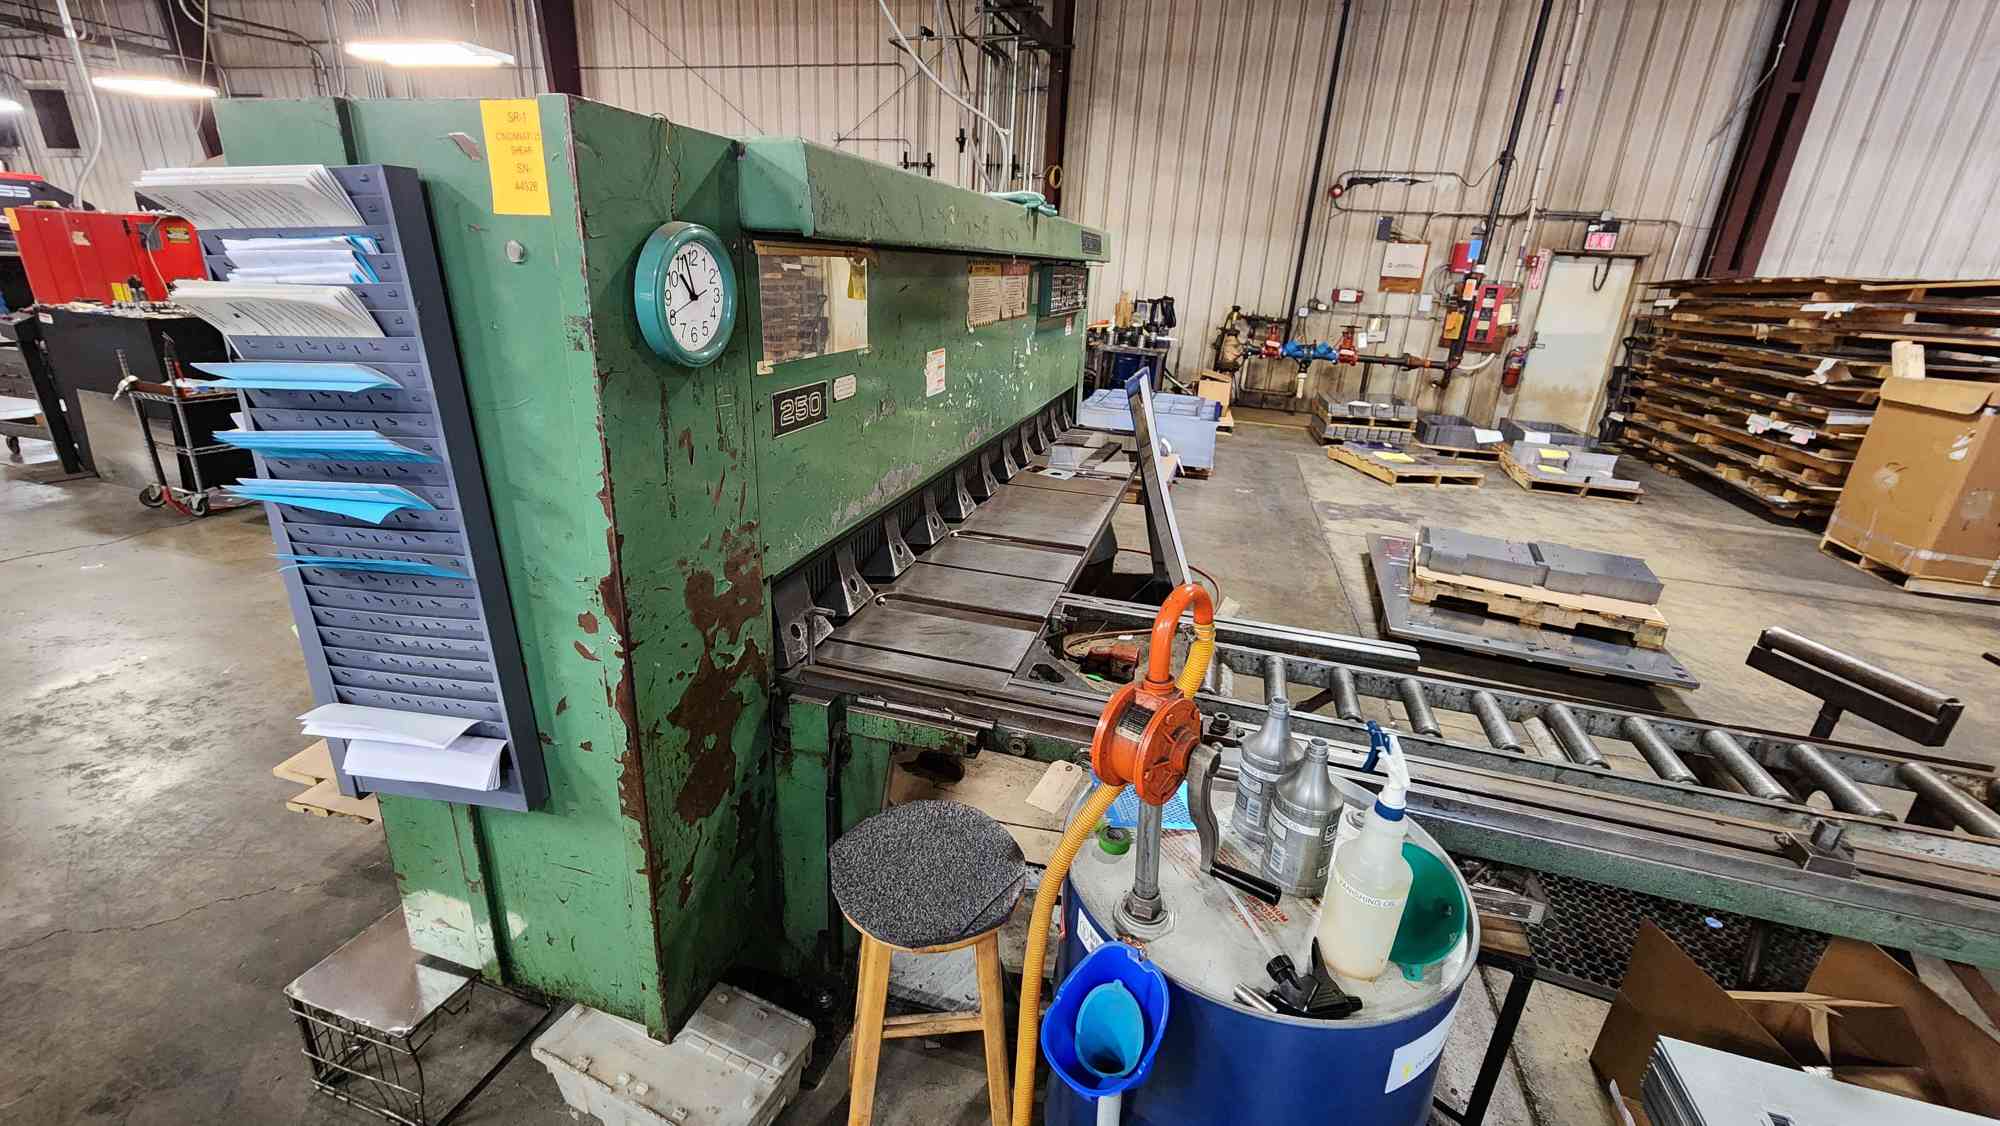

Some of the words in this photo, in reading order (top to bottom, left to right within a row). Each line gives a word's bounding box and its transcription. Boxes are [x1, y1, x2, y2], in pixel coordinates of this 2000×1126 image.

[688, 249, 698, 266] 12
[667, 270, 679, 289] 10
[709, 268, 716, 285] 2
[665, 289, 672, 306] 9
[713, 288, 720, 303] 3
[670, 309, 677, 326] 8
[710, 306, 716, 320] 4
[680, 322, 687, 338] 7
[690, 326, 698, 343] 6
[702, 320, 709, 336] 5
[780, 391, 822, 427] 250
